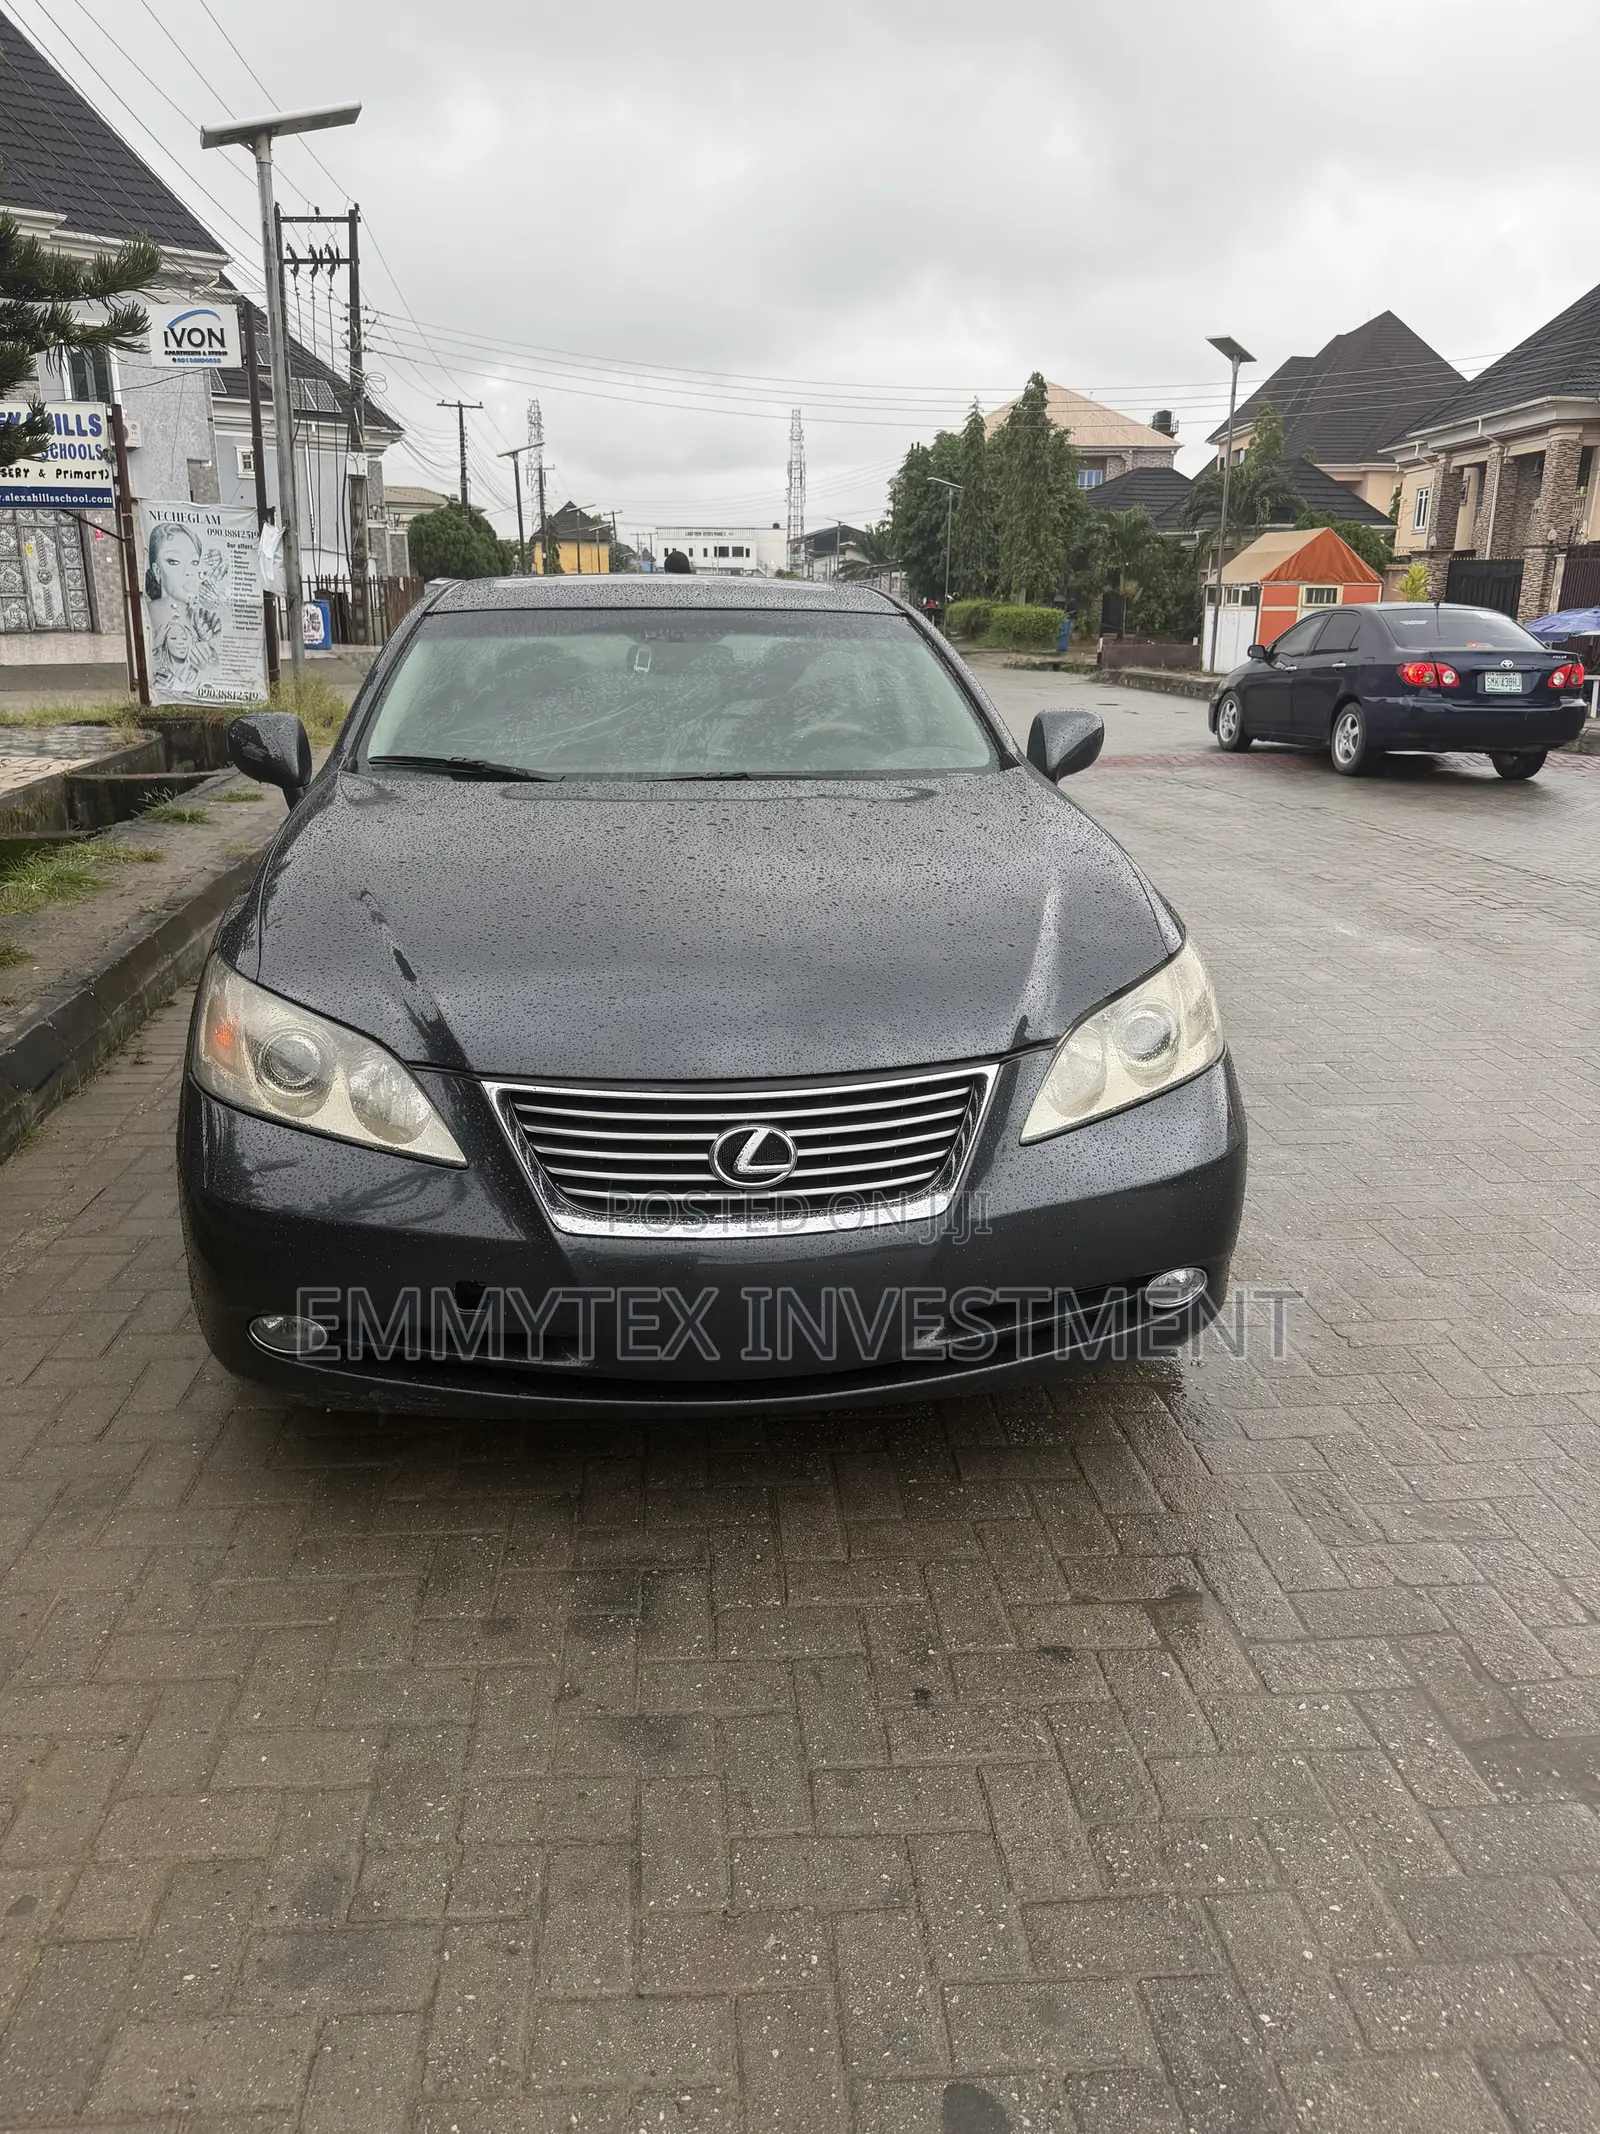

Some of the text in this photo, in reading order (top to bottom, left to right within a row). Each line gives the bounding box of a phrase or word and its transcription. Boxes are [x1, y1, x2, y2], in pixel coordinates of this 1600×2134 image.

[47, 412, 103, 437] ILLS
[38, 468, 46, 478] &
[0, 492, 112, 504] .alexahillsschool.com
[149, 510, 221, 525] NECHEGLAM
